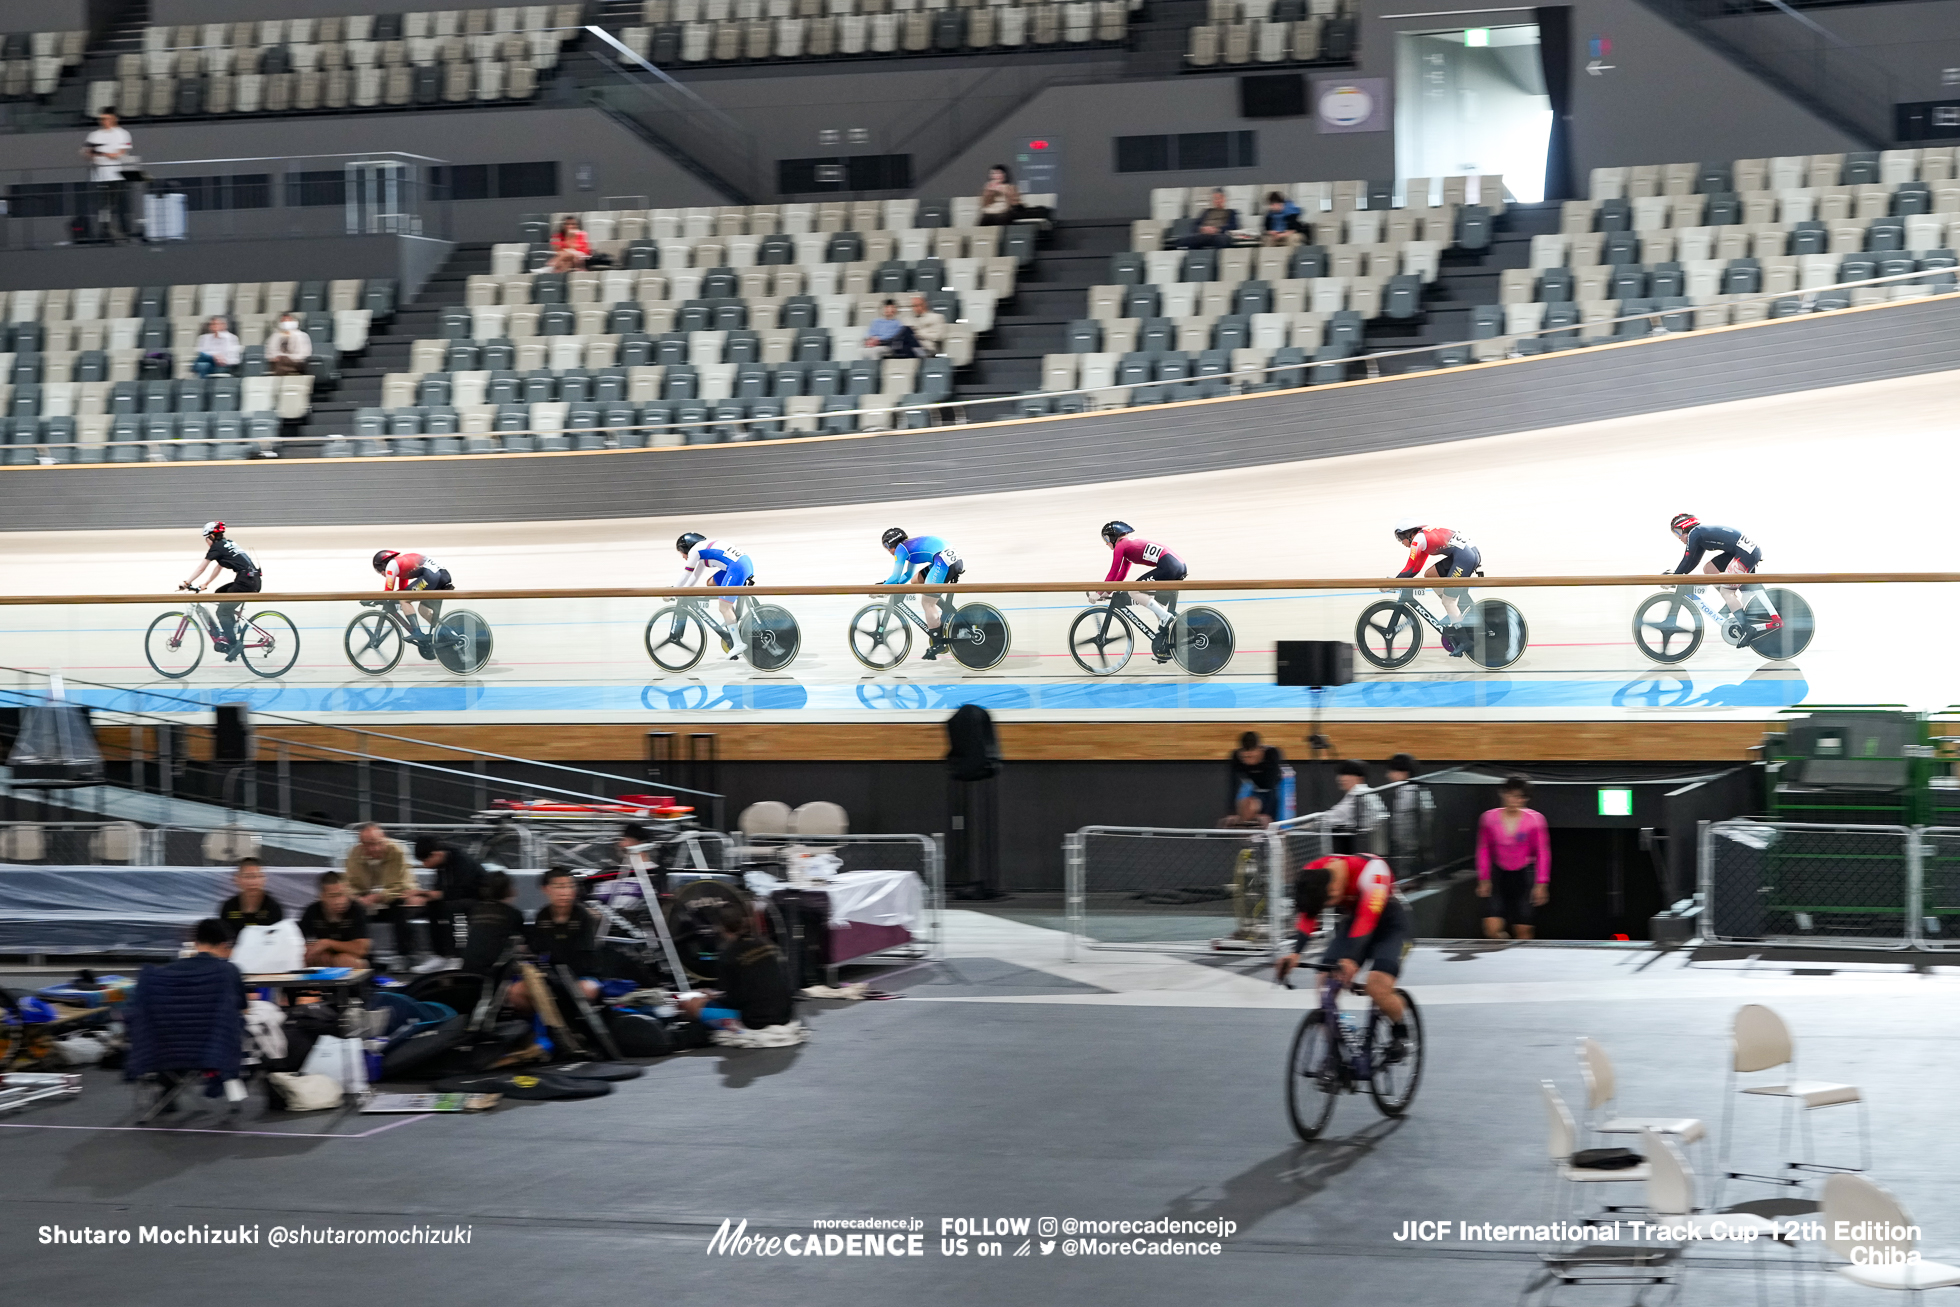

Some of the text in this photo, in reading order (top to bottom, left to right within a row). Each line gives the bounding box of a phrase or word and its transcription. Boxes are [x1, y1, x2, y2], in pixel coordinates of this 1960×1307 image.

[1145, 544, 1162, 557] 101
[896, 601, 930, 633] BRIDGESTONE
[1120, 607, 1157, 640] ARGON 18
[1414, 604, 1444, 634] KOGA
